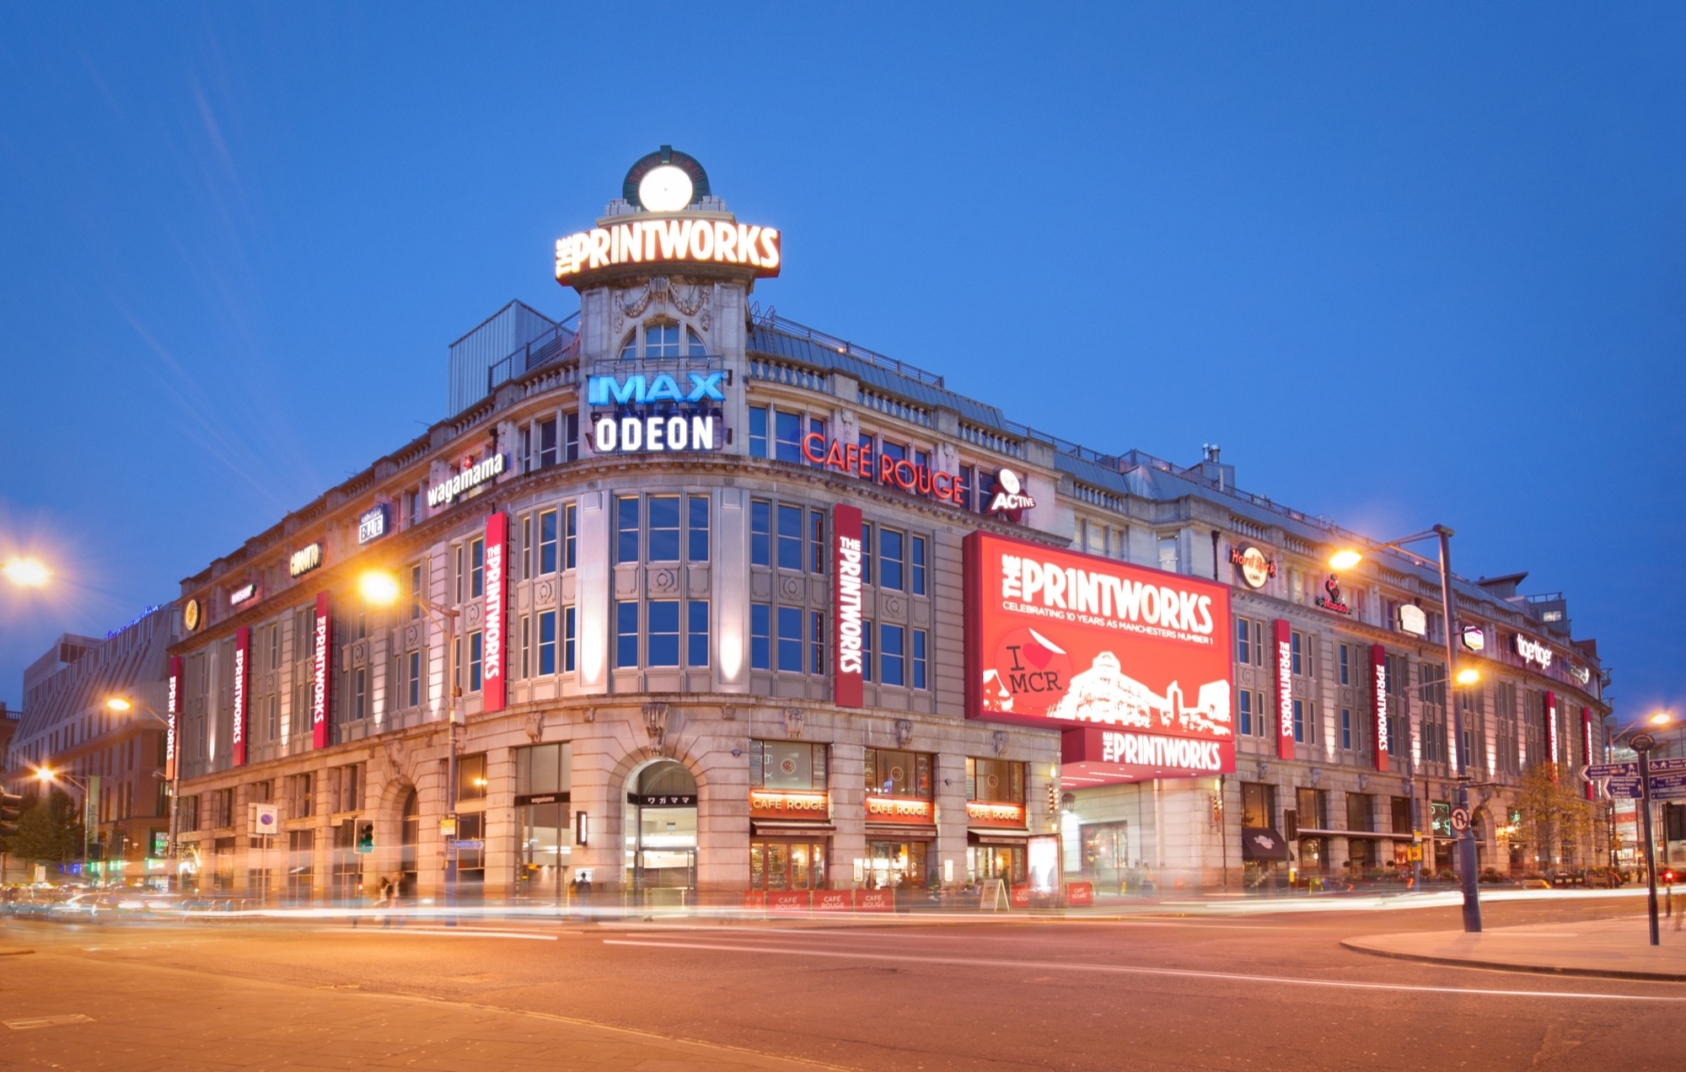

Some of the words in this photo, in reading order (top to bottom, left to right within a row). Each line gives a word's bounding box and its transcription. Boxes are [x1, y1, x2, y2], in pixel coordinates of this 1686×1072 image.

[556, 235, 573, 278] THE
[572, 219, 779, 273] PRINTWORKS
[588, 371, 726, 406] IMAX
[596, 416, 713, 451] ODEON
[428, 453, 503, 507] wagamama
[802, 432, 872, 478] CAFÉ
[880, 453, 964, 504] ROUGE
[991, 492, 1035, 511] ACTIVE
[361, 517, 382, 541] BLUE
[840, 536, 861, 551] THE
[487, 543, 502, 558] THE
[1232, 548, 1255, 568] Hard
[1255, 556, 1277, 578] Rock
[839, 547, 862, 674] PRINTWORKS
[1002, 554, 1022, 598] THE
[1022, 557, 1213, 635] PRINTWORKS
[484, 555, 502, 681] PRINTWORKS
[1002, 601, 1065, 620] CELEBRATING
[1066, 612, 1076, 621] 10
[1077, 613, 1105, 627] YEARS
[1106, 619, 1118, 629] AS
[1119, 621, 1177, 639] MANCHESTERS
[1177, 631, 1209, 645] NUMBER
[314, 624, 327, 724] PRINTWORKS
[1006, 645, 1025, 671] I
[1009, 670, 1063, 694] MCR
[1280, 649, 1293, 737] PRINTWORKS
[233, 656, 244, 744] PRINTWORKS
[1376, 671, 1388, 751] PRINTWORKS
[1103, 732, 1114, 762] THE
[1113, 733, 1221, 771] PRINTWORKS
[648, 796, 690, 805] ワガママ
[787, 800, 825, 811] ROUGE
[897, 805, 928, 816] ROUGE
[993, 810, 1020, 820] ROUGE
[821, 902, 844, 910] ROUGE
[862, 900, 885, 908] ROUGE
